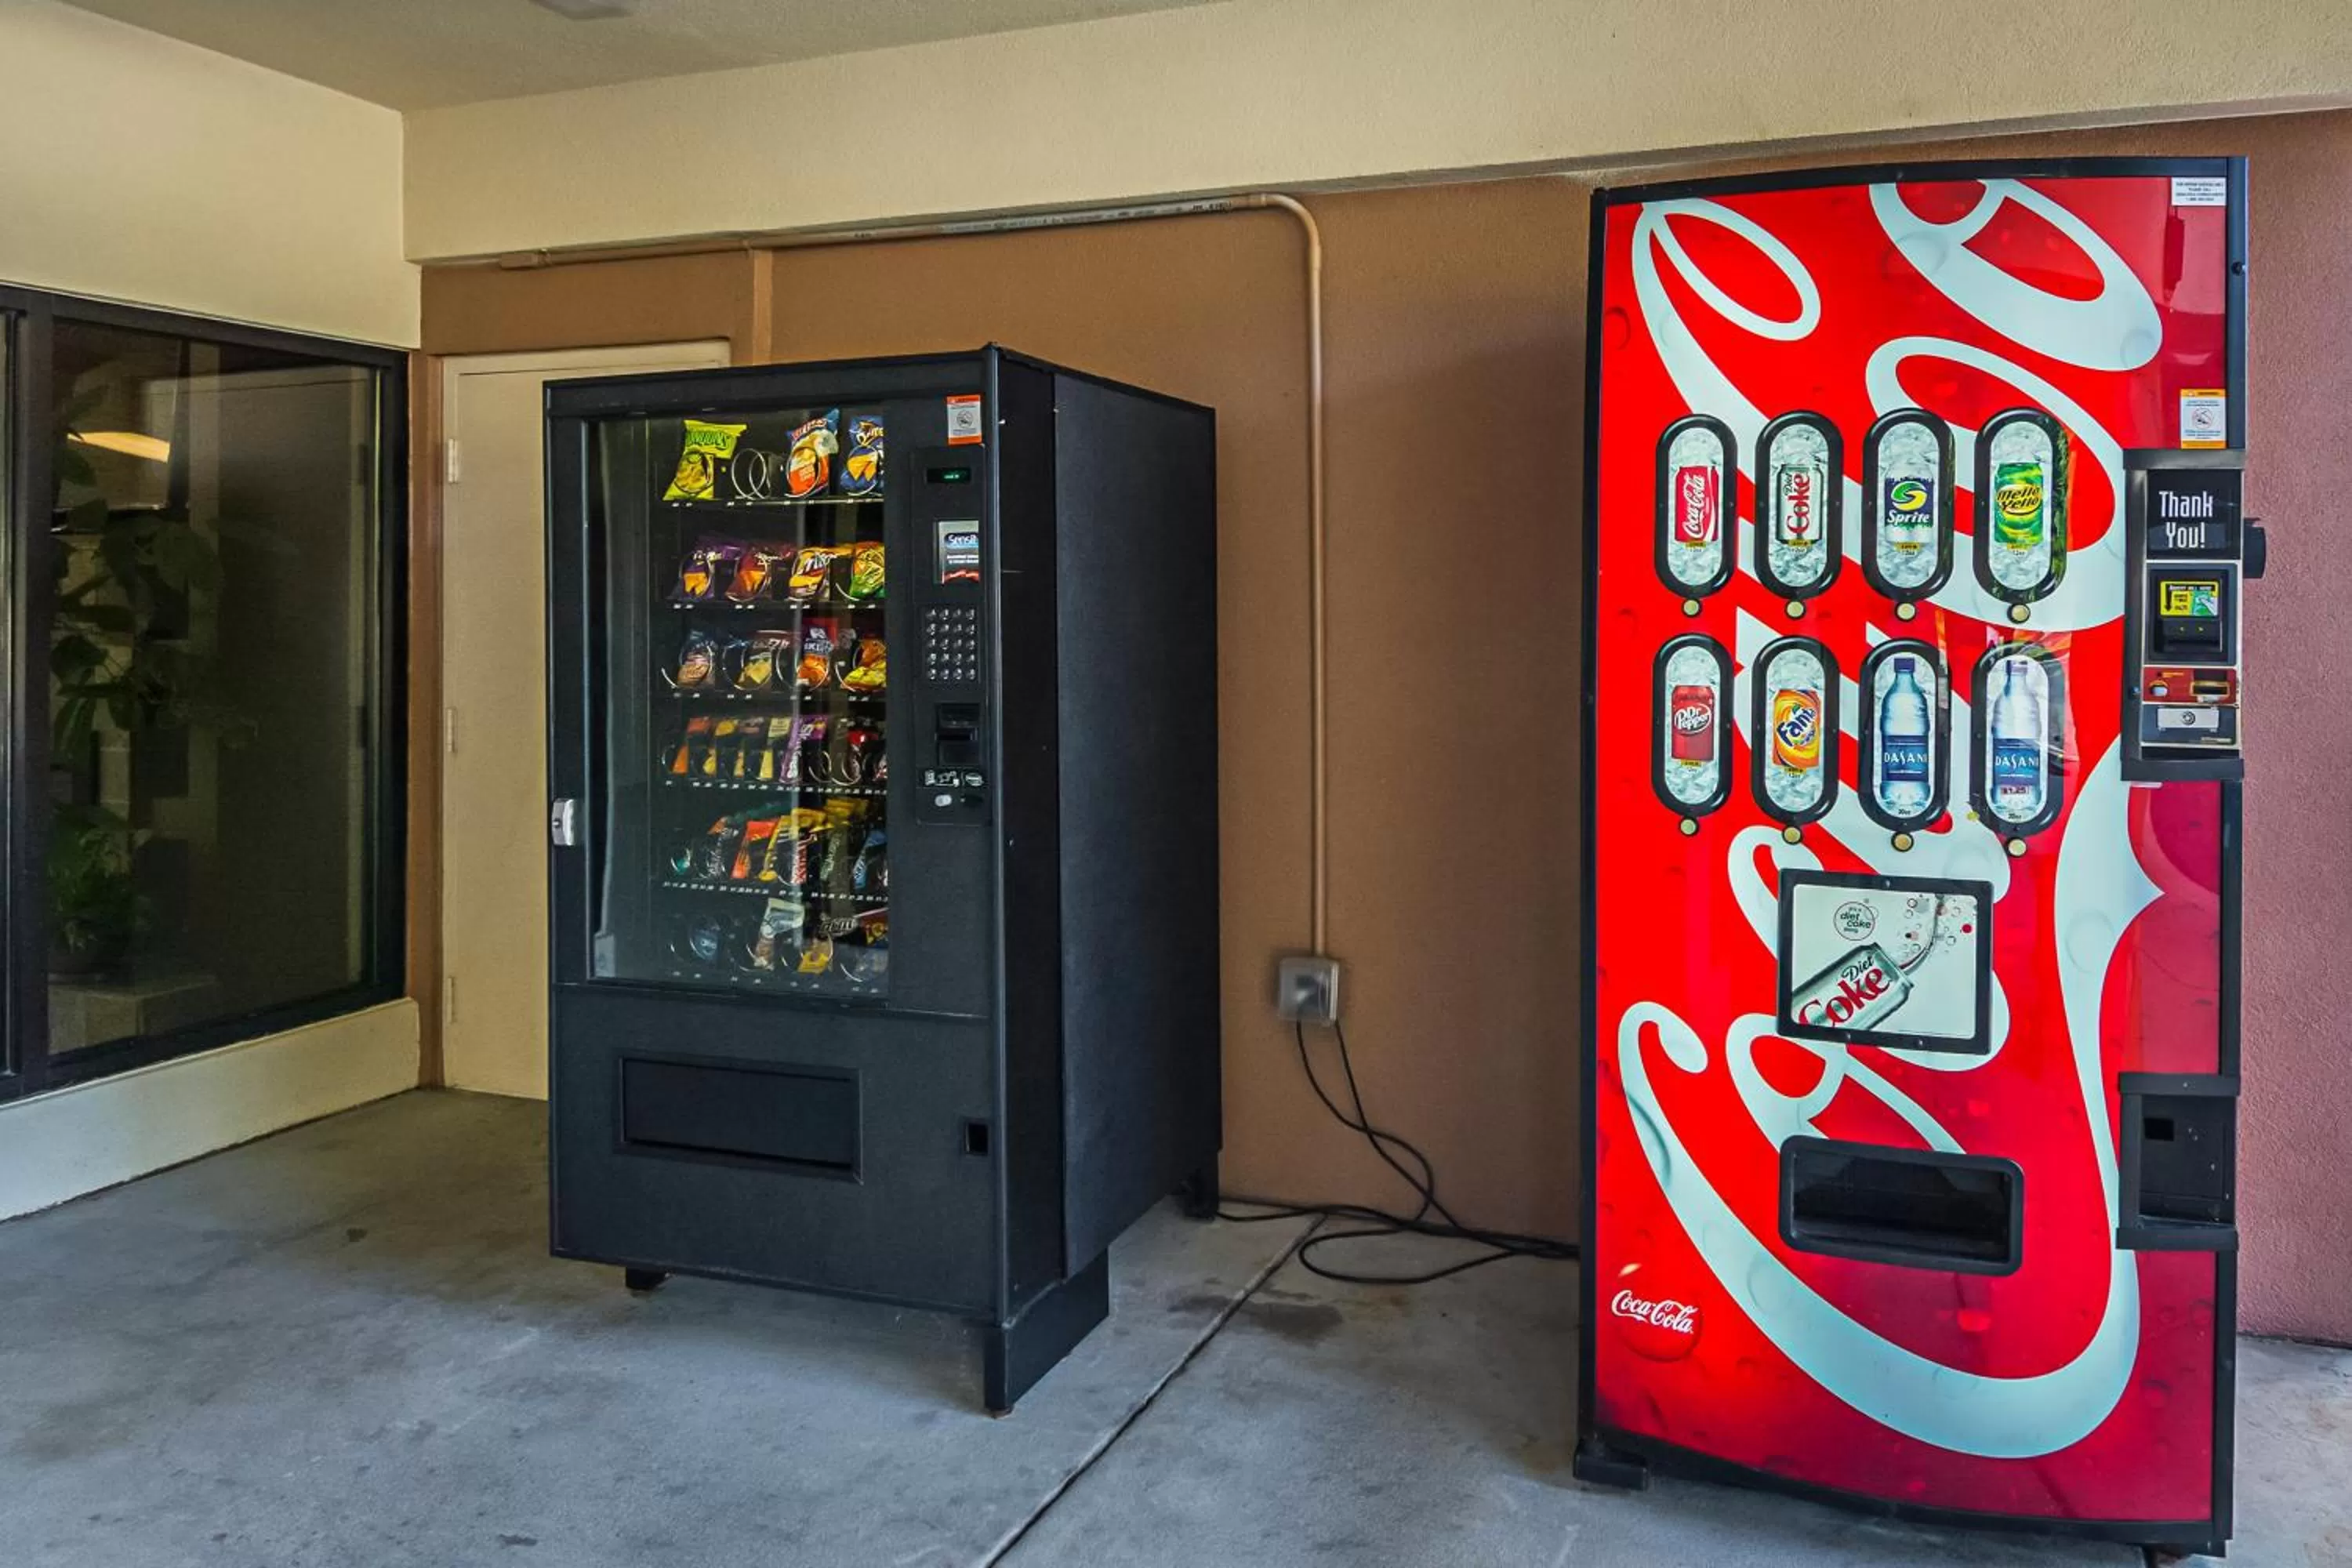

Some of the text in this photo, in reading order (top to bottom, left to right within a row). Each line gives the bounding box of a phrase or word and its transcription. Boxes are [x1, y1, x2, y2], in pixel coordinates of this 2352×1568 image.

[1787, 474, 1810, 534] Coke
[1888, 509, 1930, 525] Sprite
[2158, 490, 2214, 517] Thank
[2165, 521, 2205, 548] You!
[1676, 709, 1708, 730] Pepper
[1686, 706, 1701, 717] Dr
[1841, 955, 1875, 982] Diet
[1798, 967, 1893, 1025] Coke
[1611, 1289, 1699, 1334] Coca-Cola
